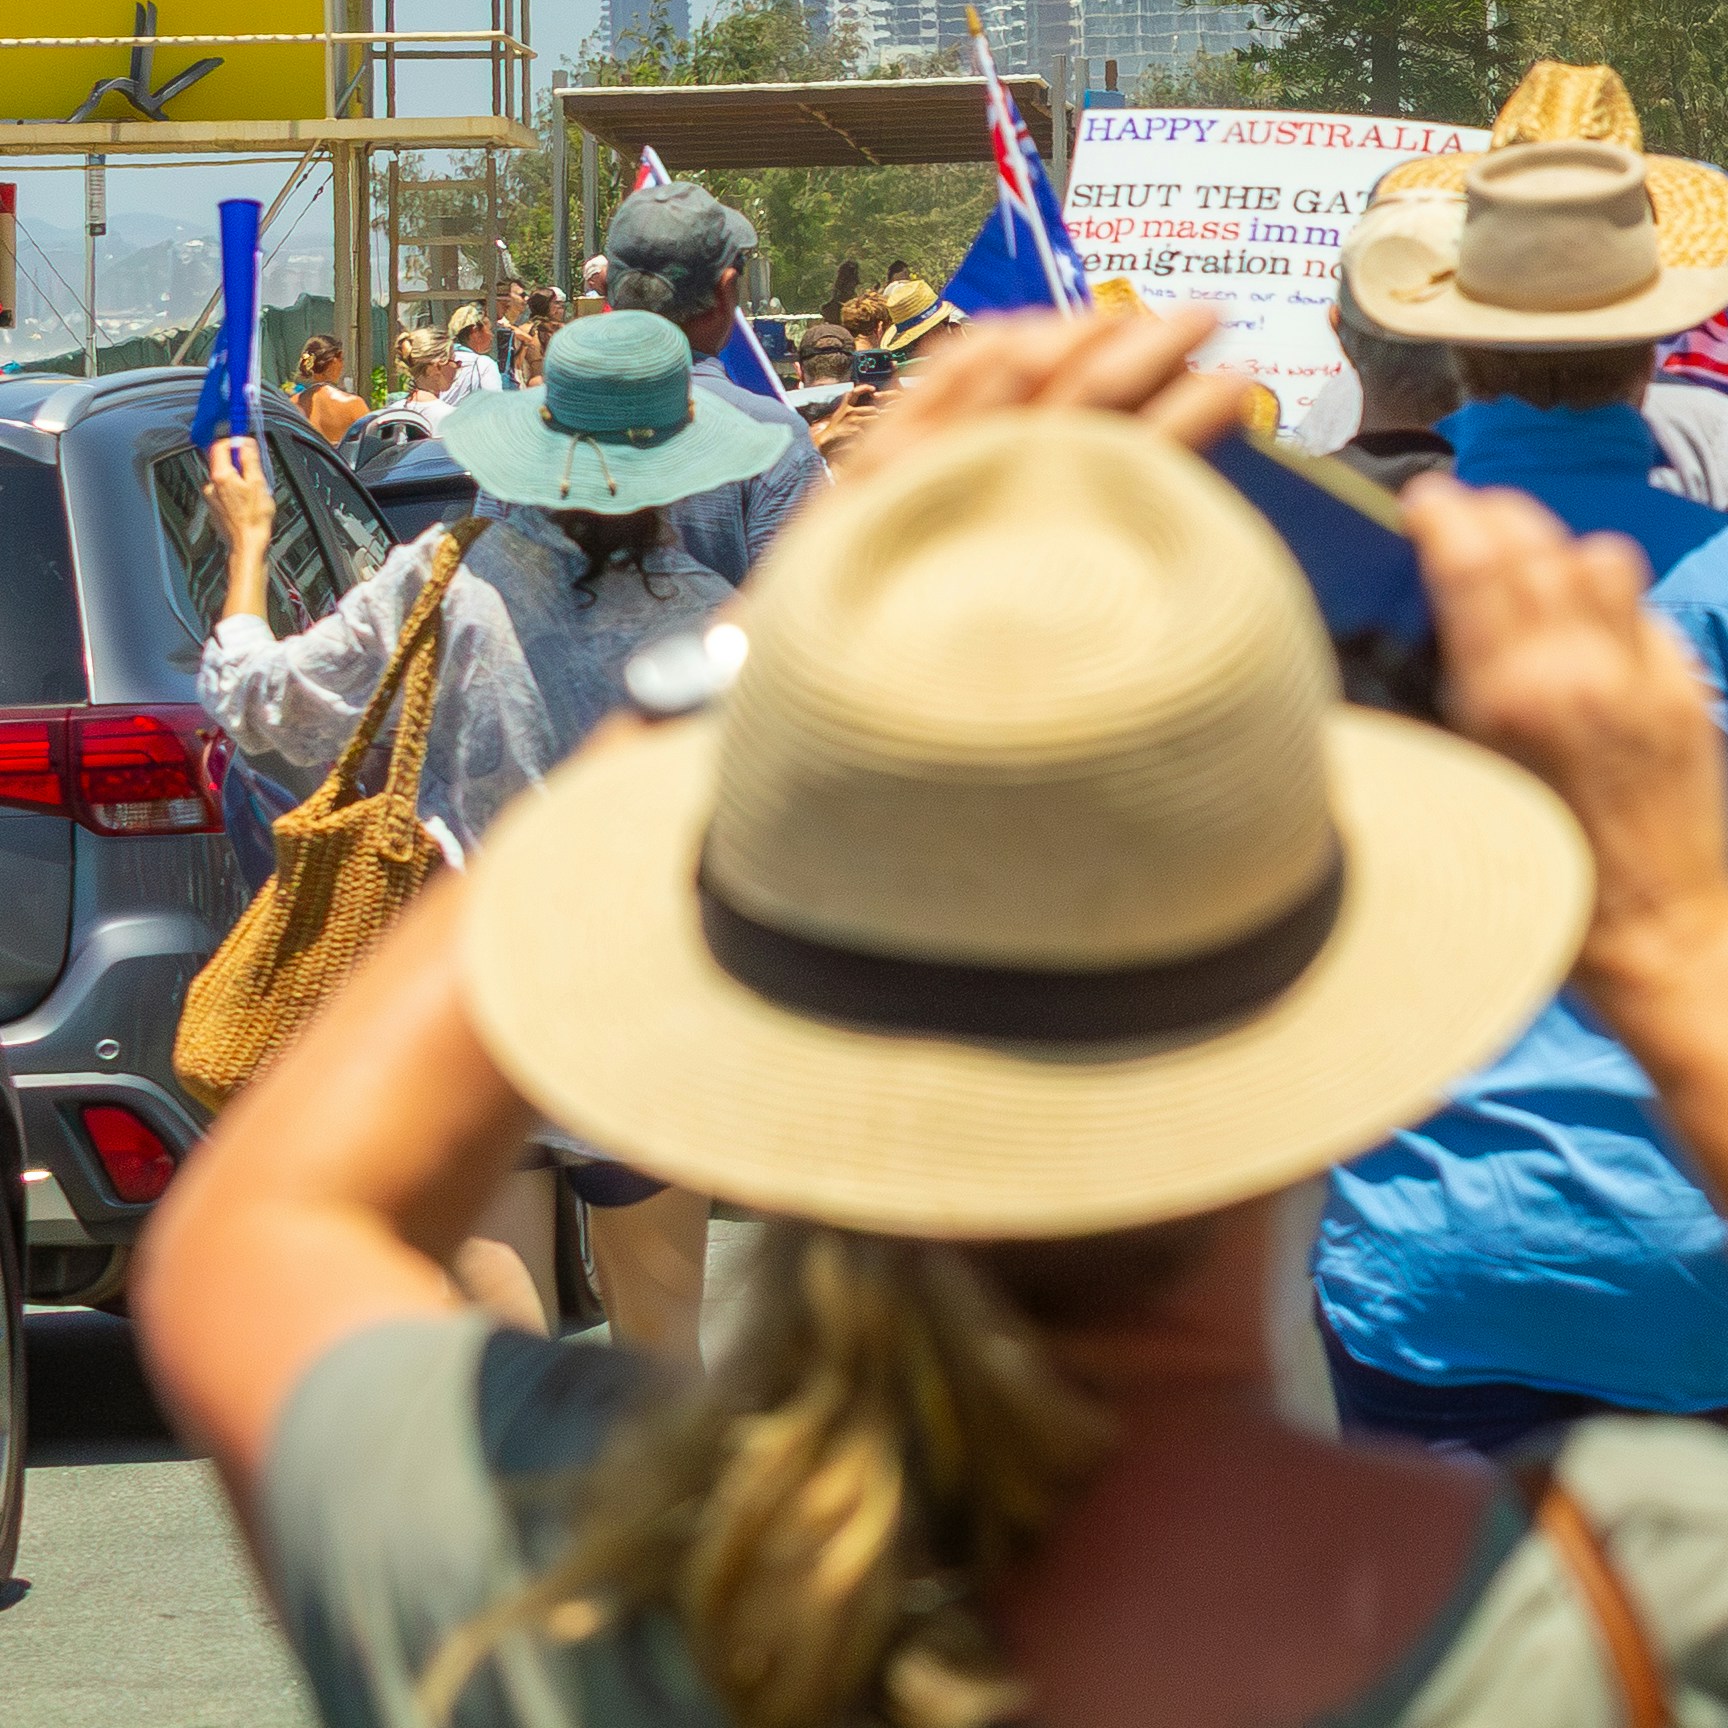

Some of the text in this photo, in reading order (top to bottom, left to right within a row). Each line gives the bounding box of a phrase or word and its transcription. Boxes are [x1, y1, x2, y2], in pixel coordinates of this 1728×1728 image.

[1083, 117, 1464, 154] HAPPY AUSTRALIA
[1071, 183, 1182, 209] SHUT
[1195, 186, 1281, 211] THE
[1066, 216, 1135, 243] stop
[1140, 219, 1241, 241] mass
[1189, 287, 1238, 301] been
